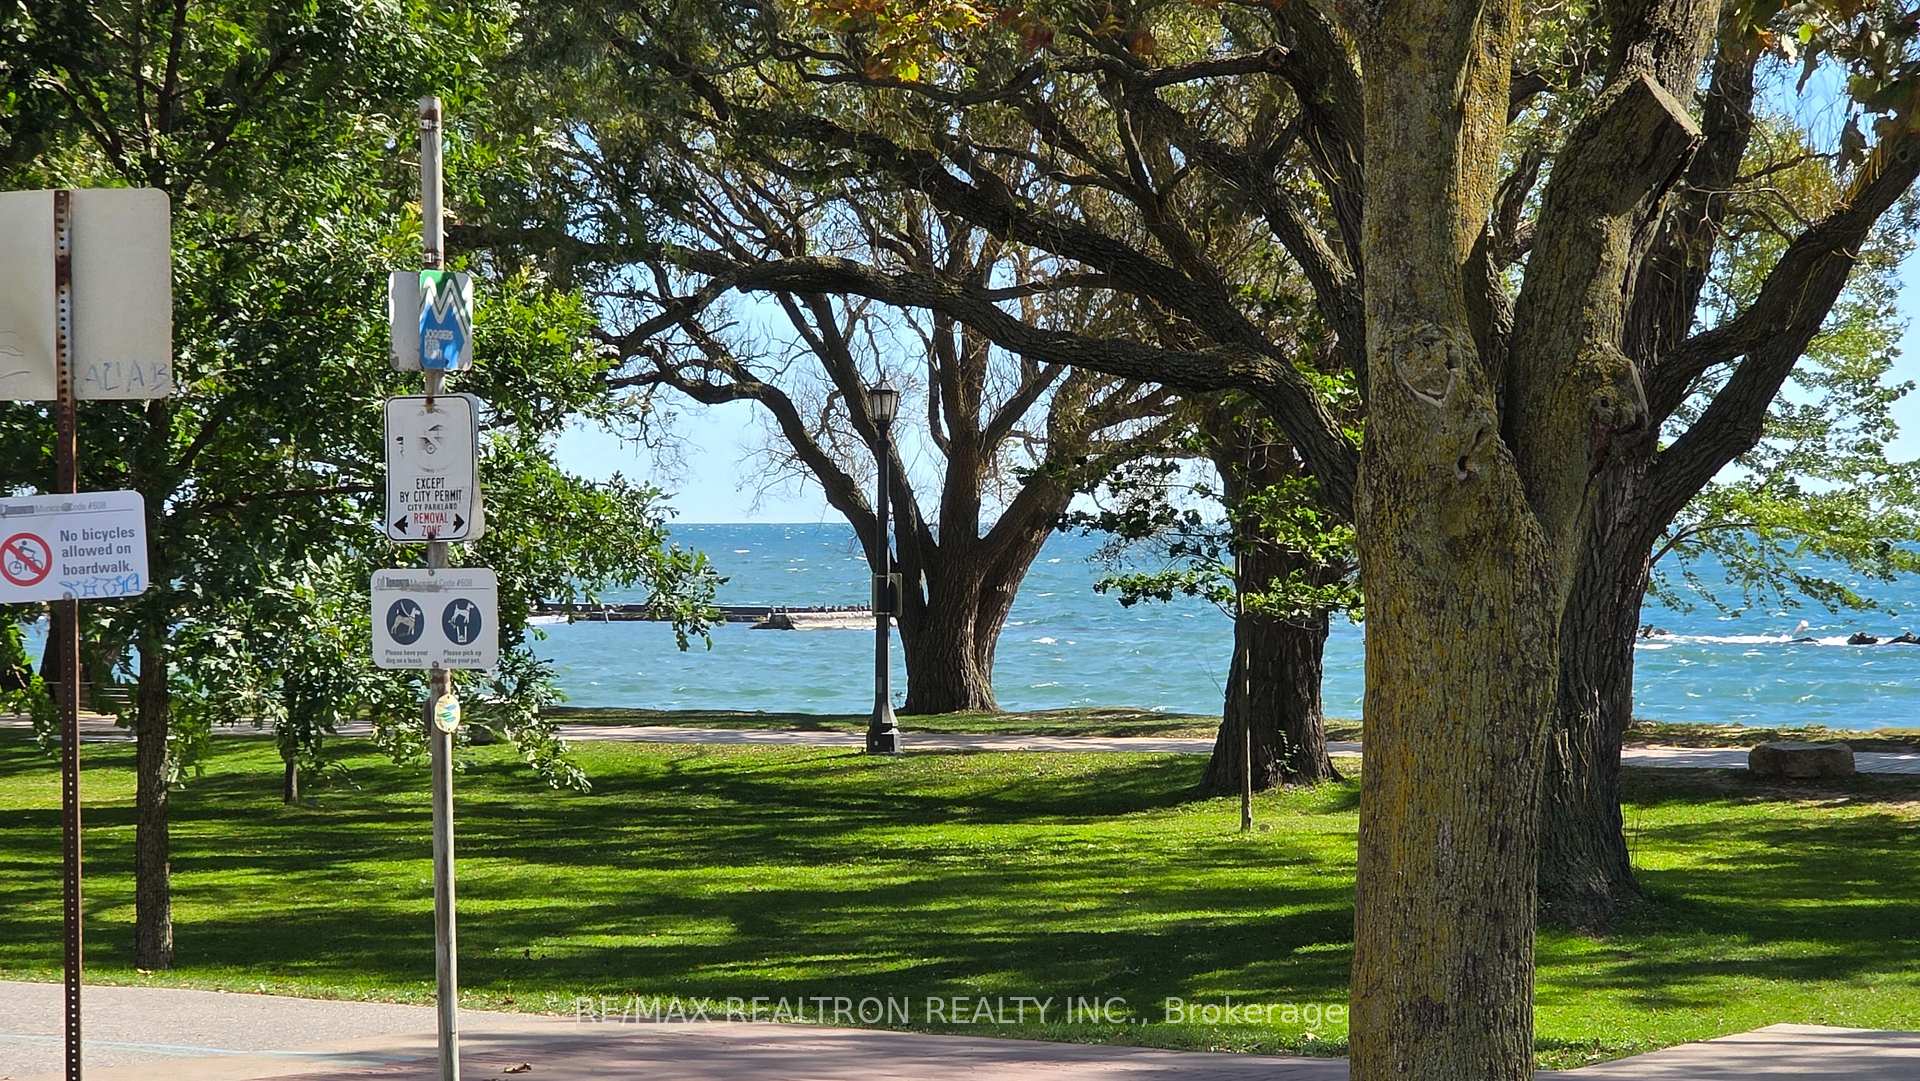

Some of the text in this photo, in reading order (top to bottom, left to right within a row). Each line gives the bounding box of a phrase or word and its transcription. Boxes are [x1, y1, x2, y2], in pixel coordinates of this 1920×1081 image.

[416, 477, 445, 490] EXCEPT
[399, 488, 462, 503] BY CITY PERMIT
[407, 502, 457, 512] CITY PARKLAND
[413, 512, 448, 524] REMOVAL
[60, 526, 135, 542] No bicycles
[62, 543, 131, 558] allowed on
[63, 561, 133, 576] boardwalk.
